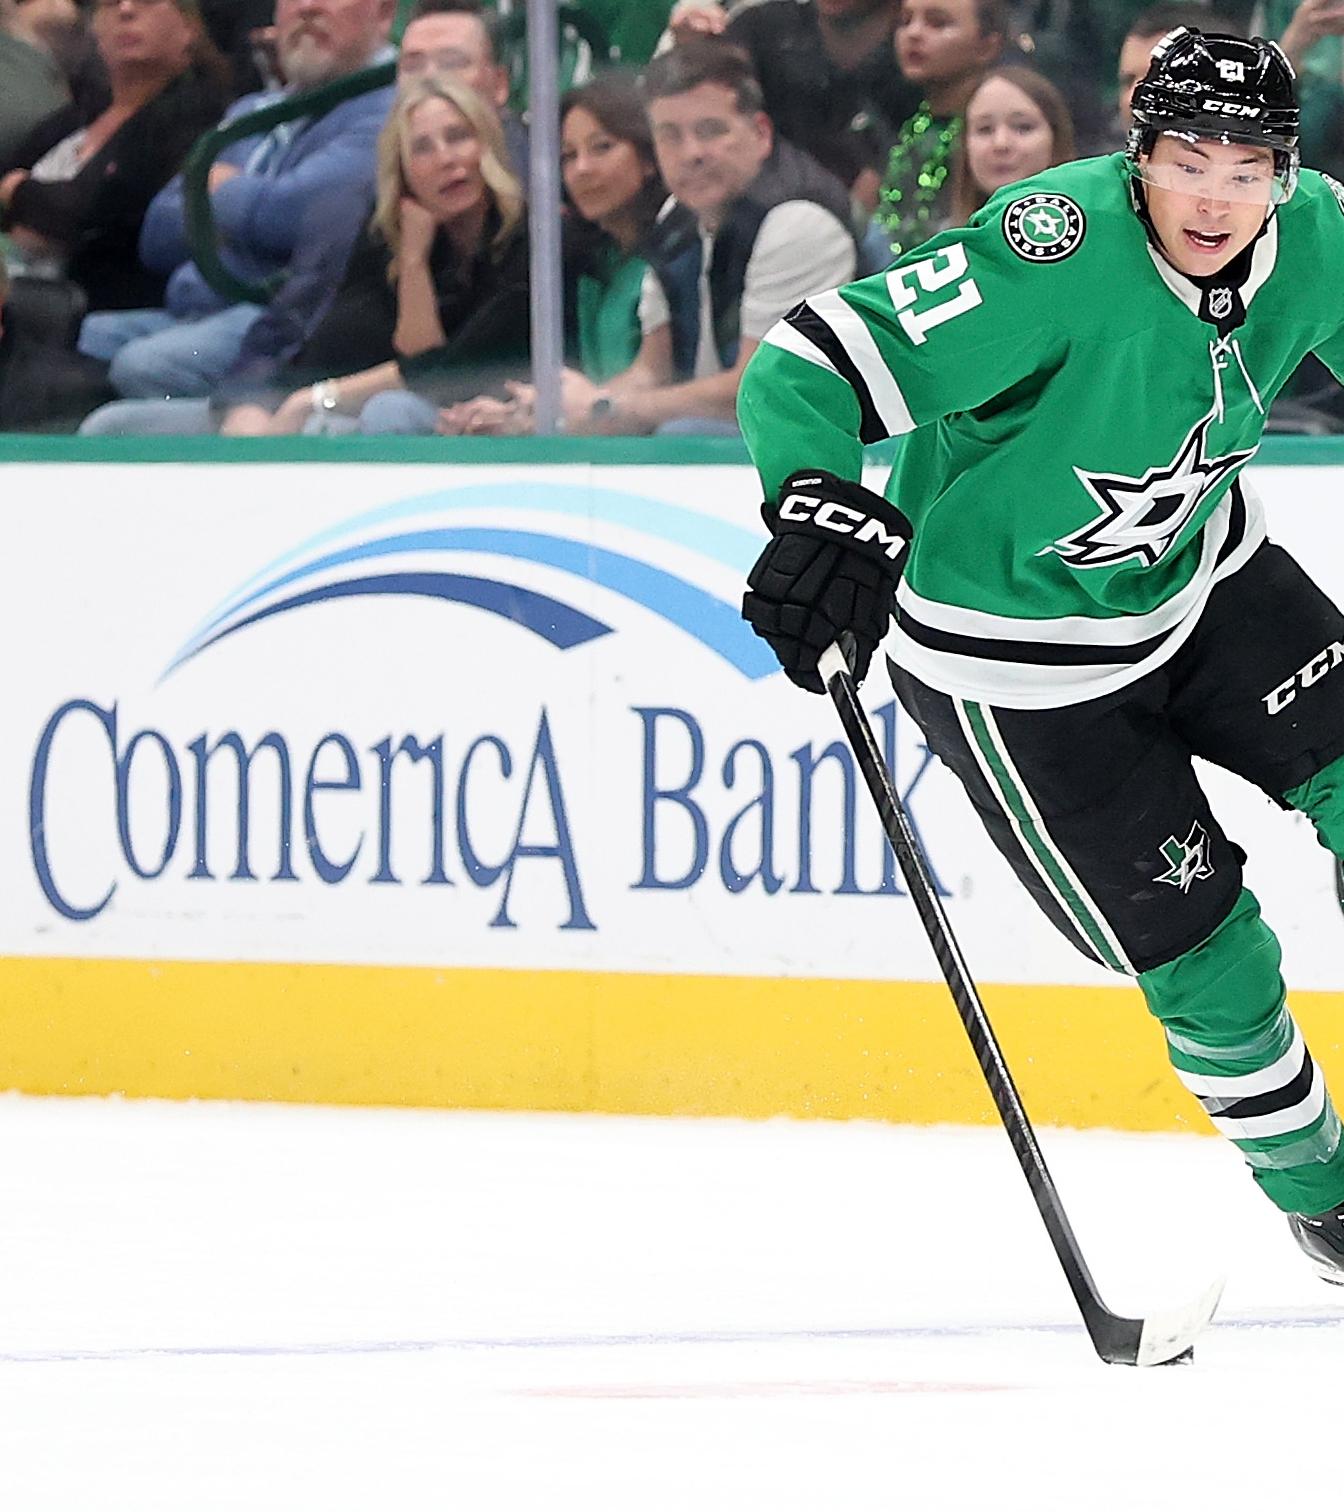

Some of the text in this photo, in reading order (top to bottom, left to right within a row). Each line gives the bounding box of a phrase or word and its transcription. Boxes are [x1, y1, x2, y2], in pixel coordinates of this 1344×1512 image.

[1220, 59, 1245, 83] 21
[1203, 99, 1260, 117] CCM
[1010, 206, 1045, 256] STARS
[1035, 197, 1077, 249] DALLAS
[885, 242, 983, 346] 21
[779, 494, 906, 560] CCM
[629, 698, 953, 897] Bank
